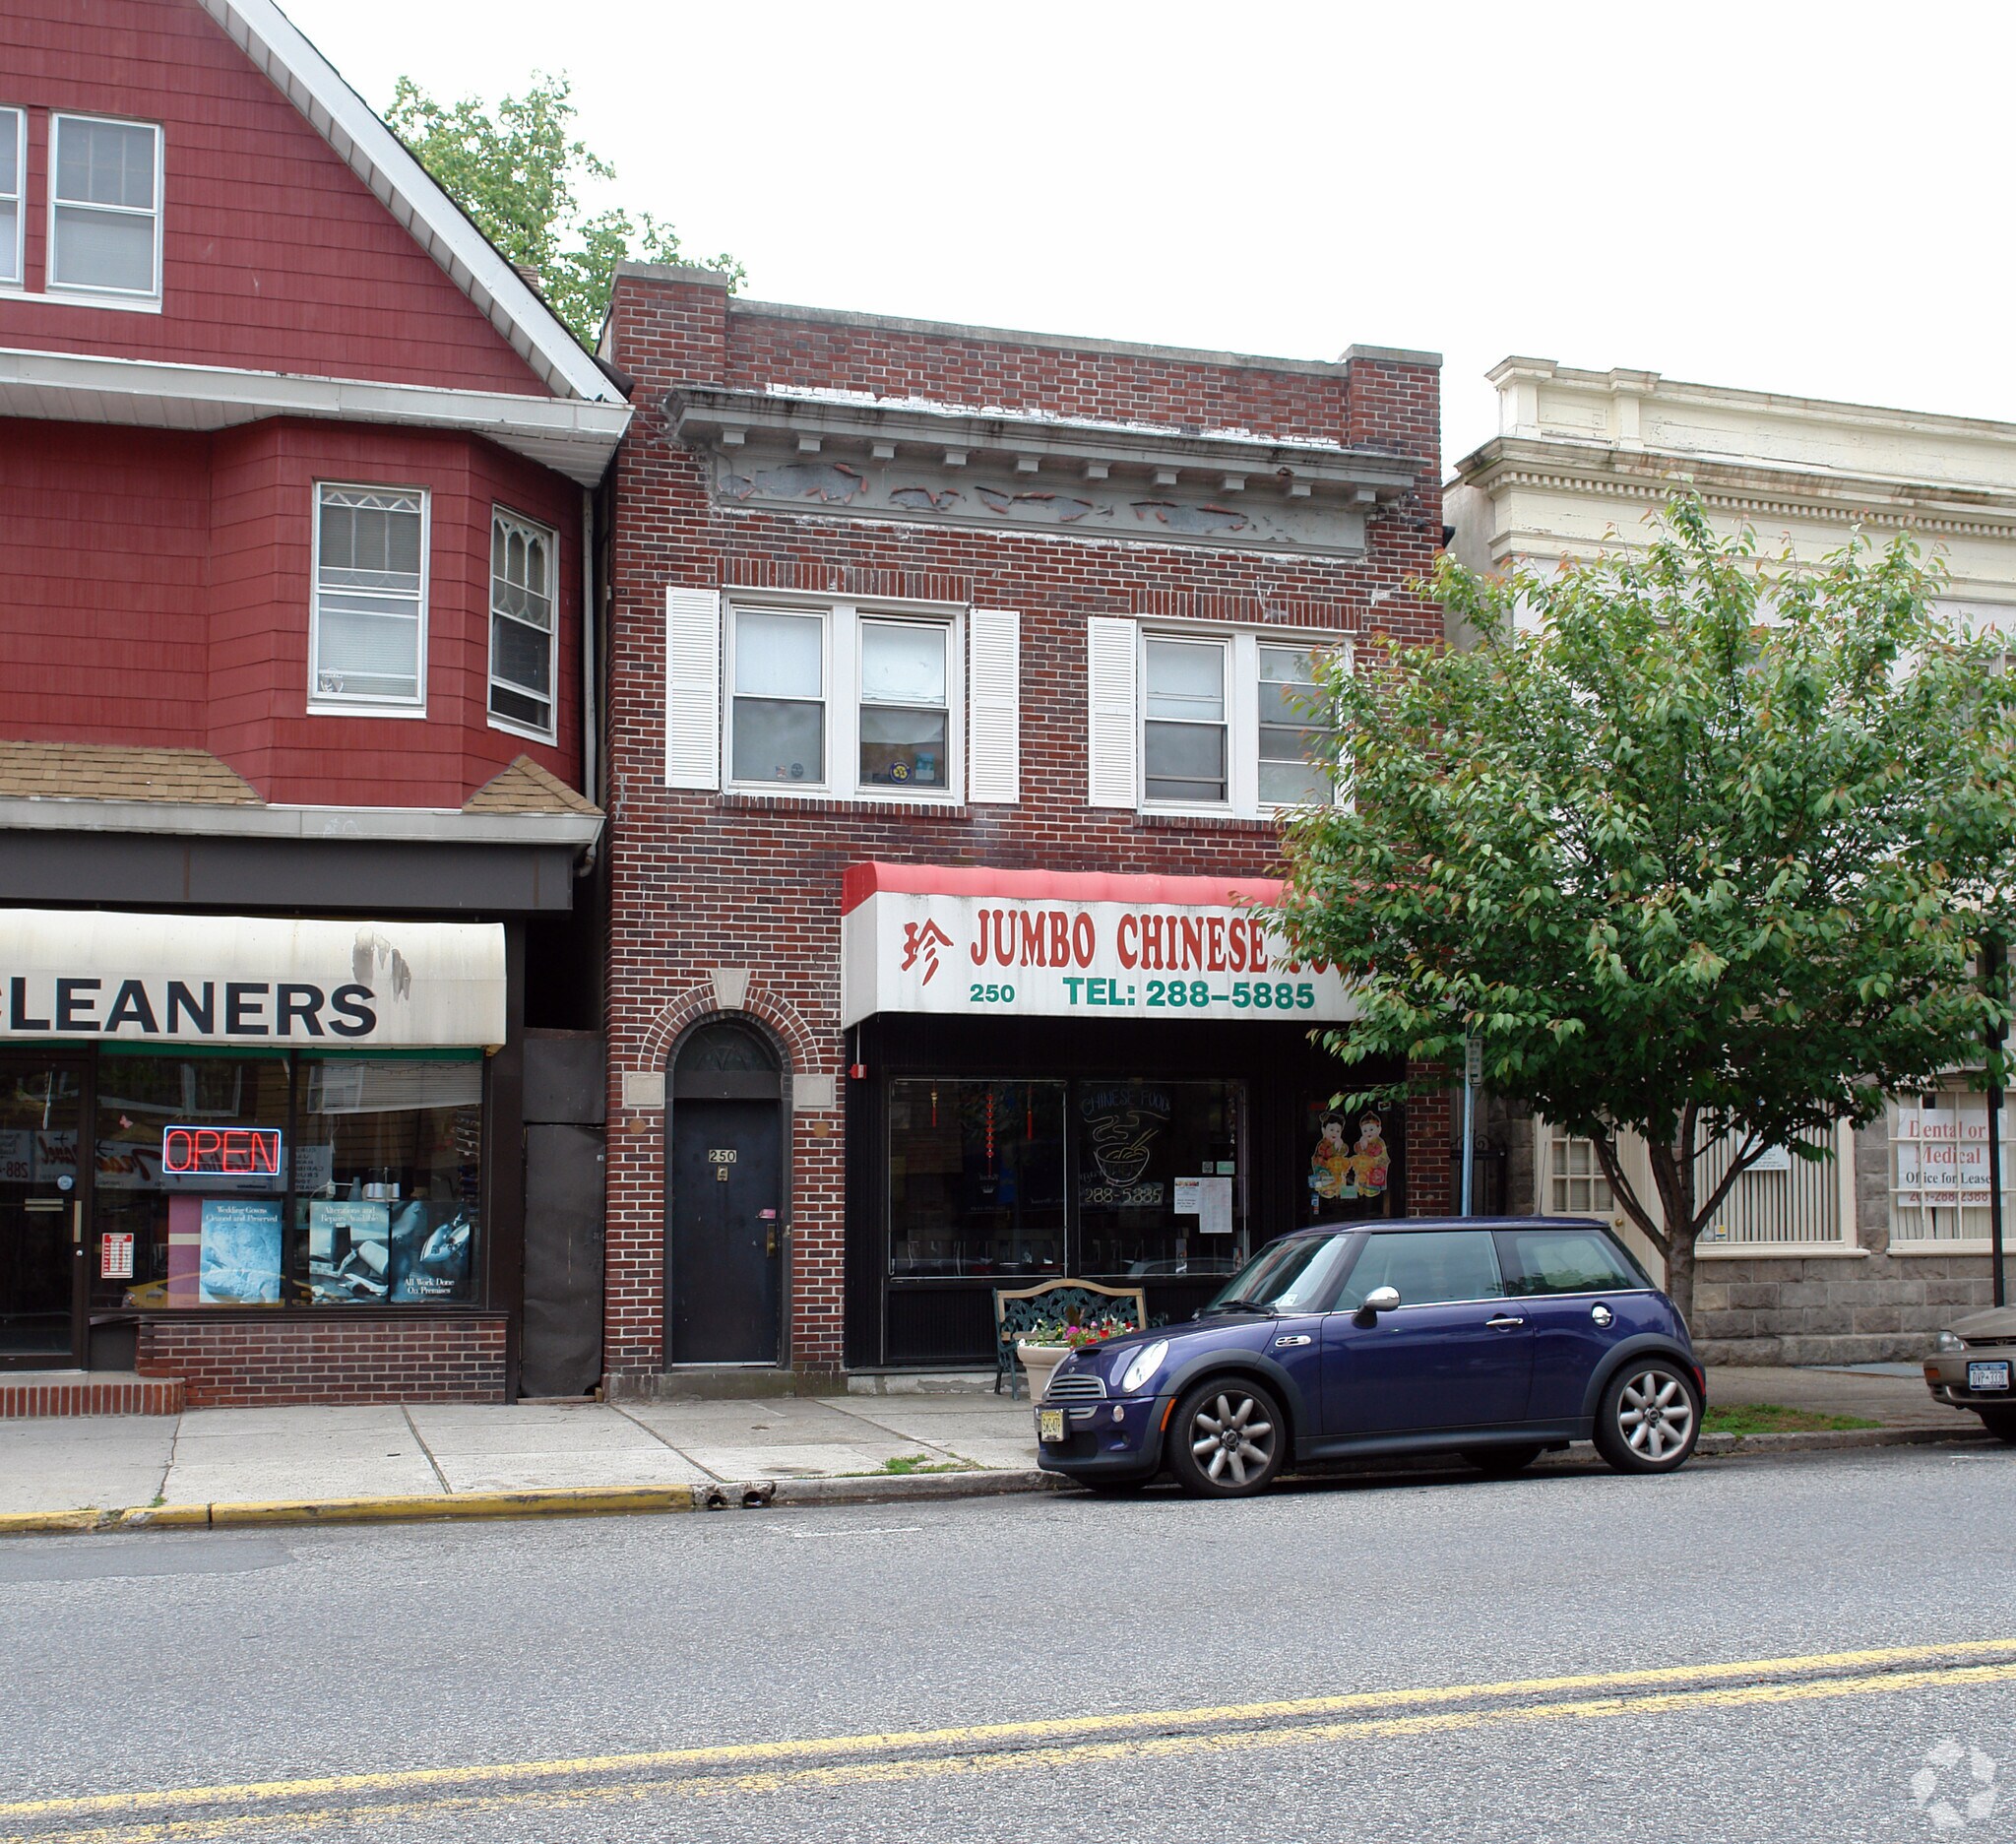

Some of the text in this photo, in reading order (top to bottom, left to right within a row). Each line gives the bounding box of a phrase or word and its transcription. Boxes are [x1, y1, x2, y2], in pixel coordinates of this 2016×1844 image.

[970, 908, 1096, 970] JUMBO
[1116, 913, 1269, 974] CHINESE
[901, 917, 955, 986] 珍
[970, 977, 1315, 1010] 250 TEL: 288-5885
[0, 976, 377, 1038] LEANERS
[1081, 1088, 1135, 1116] CHINESE
[1909, 1119, 1986, 1139] Dental or
[165, 1129, 279, 1173] OPEN
[710, 1150, 735, 1162] 250
[1915, 1145, 1981, 1165] Medical
[1906, 1171, 1938, 1184] Ofice
[1941, 1171, 1957, 1184] for
[1085, 1187, 1163, 1203] 288-5885
[217, 1205, 268, 1215] Wedding Gowns
[321, 1214, 346, 1224] Repairs
[407, 1286, 451, 1295] On Premises
